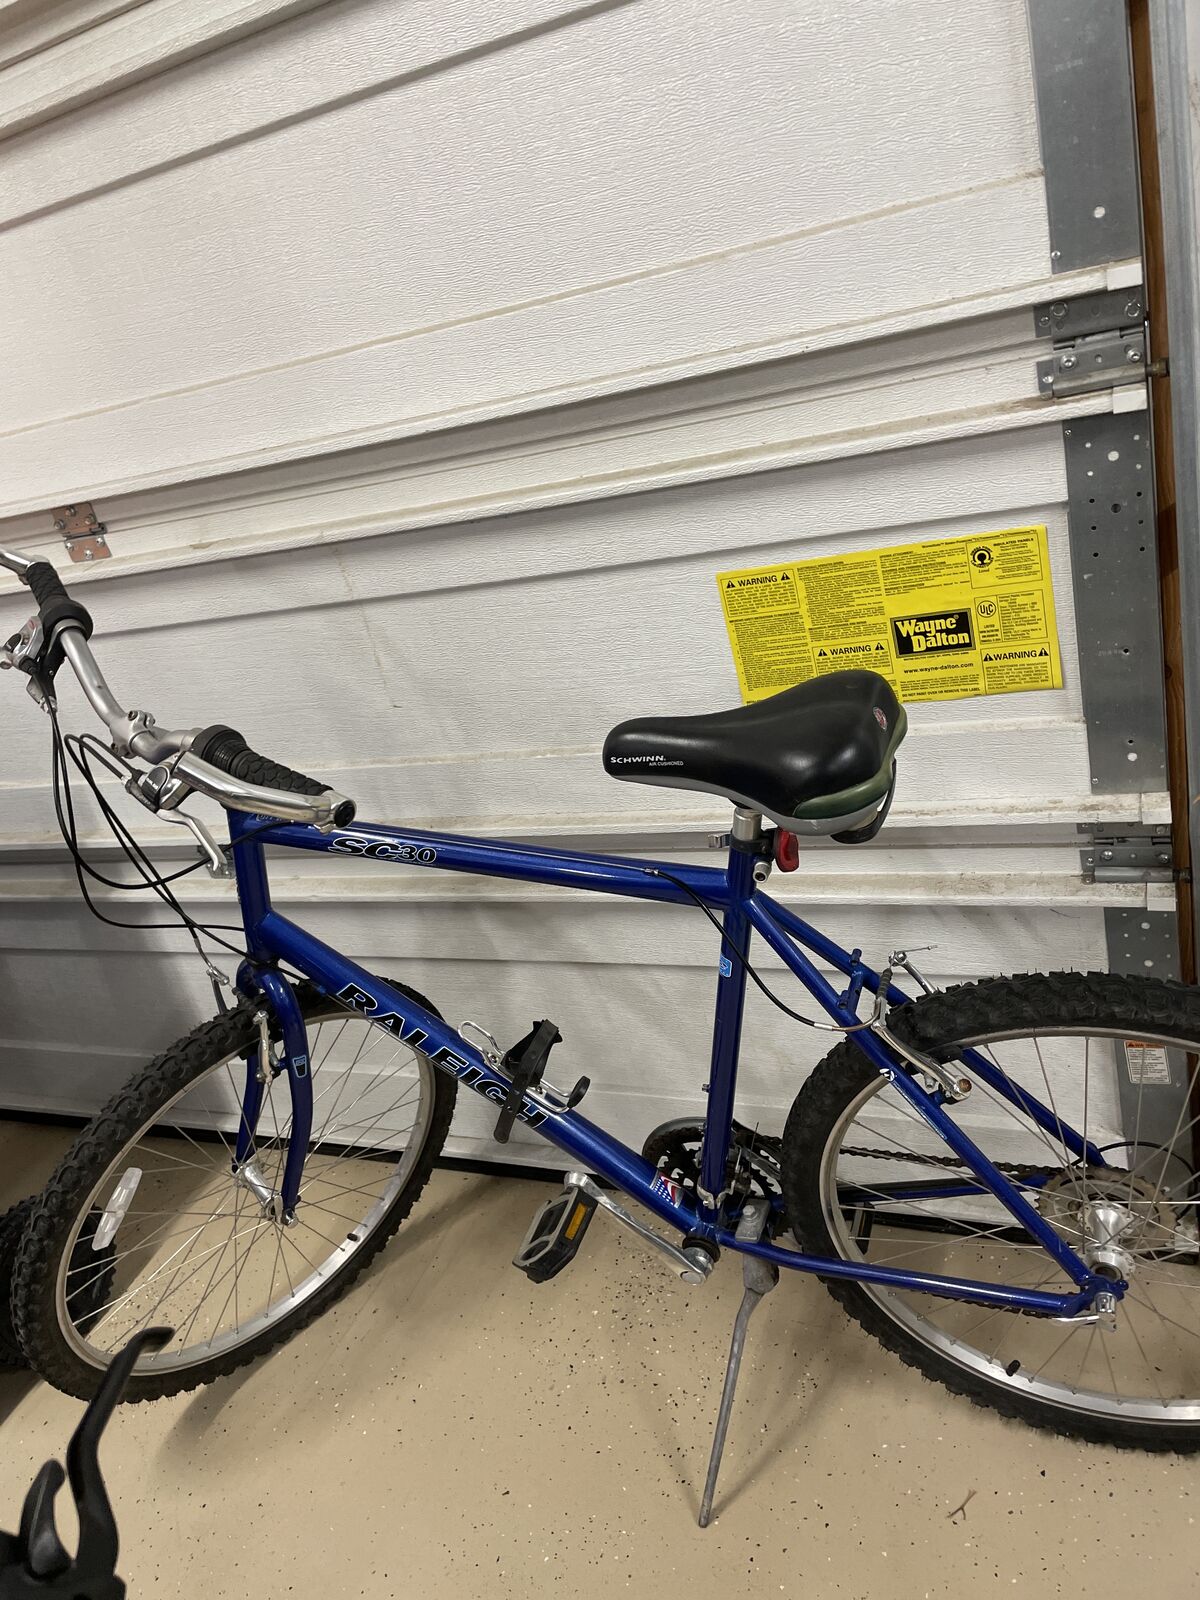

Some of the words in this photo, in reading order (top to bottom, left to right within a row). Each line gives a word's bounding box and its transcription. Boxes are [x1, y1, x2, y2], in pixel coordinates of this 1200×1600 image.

[738, 575, 778, 587] WARNING
[979, 603, 994, 615] ULC
[896, 617, 957, 638] Wayne
[911, 632, 970, 652] Dalton
[830, 645, 872, 656] WARNING
[993, 650, 1037, 660] WARNING
[904, 662, 974, 674] www.wayne-dalton.com
[610, 755, 665, 764] SCHWINN
[328, 837, 437, 863] SC30
